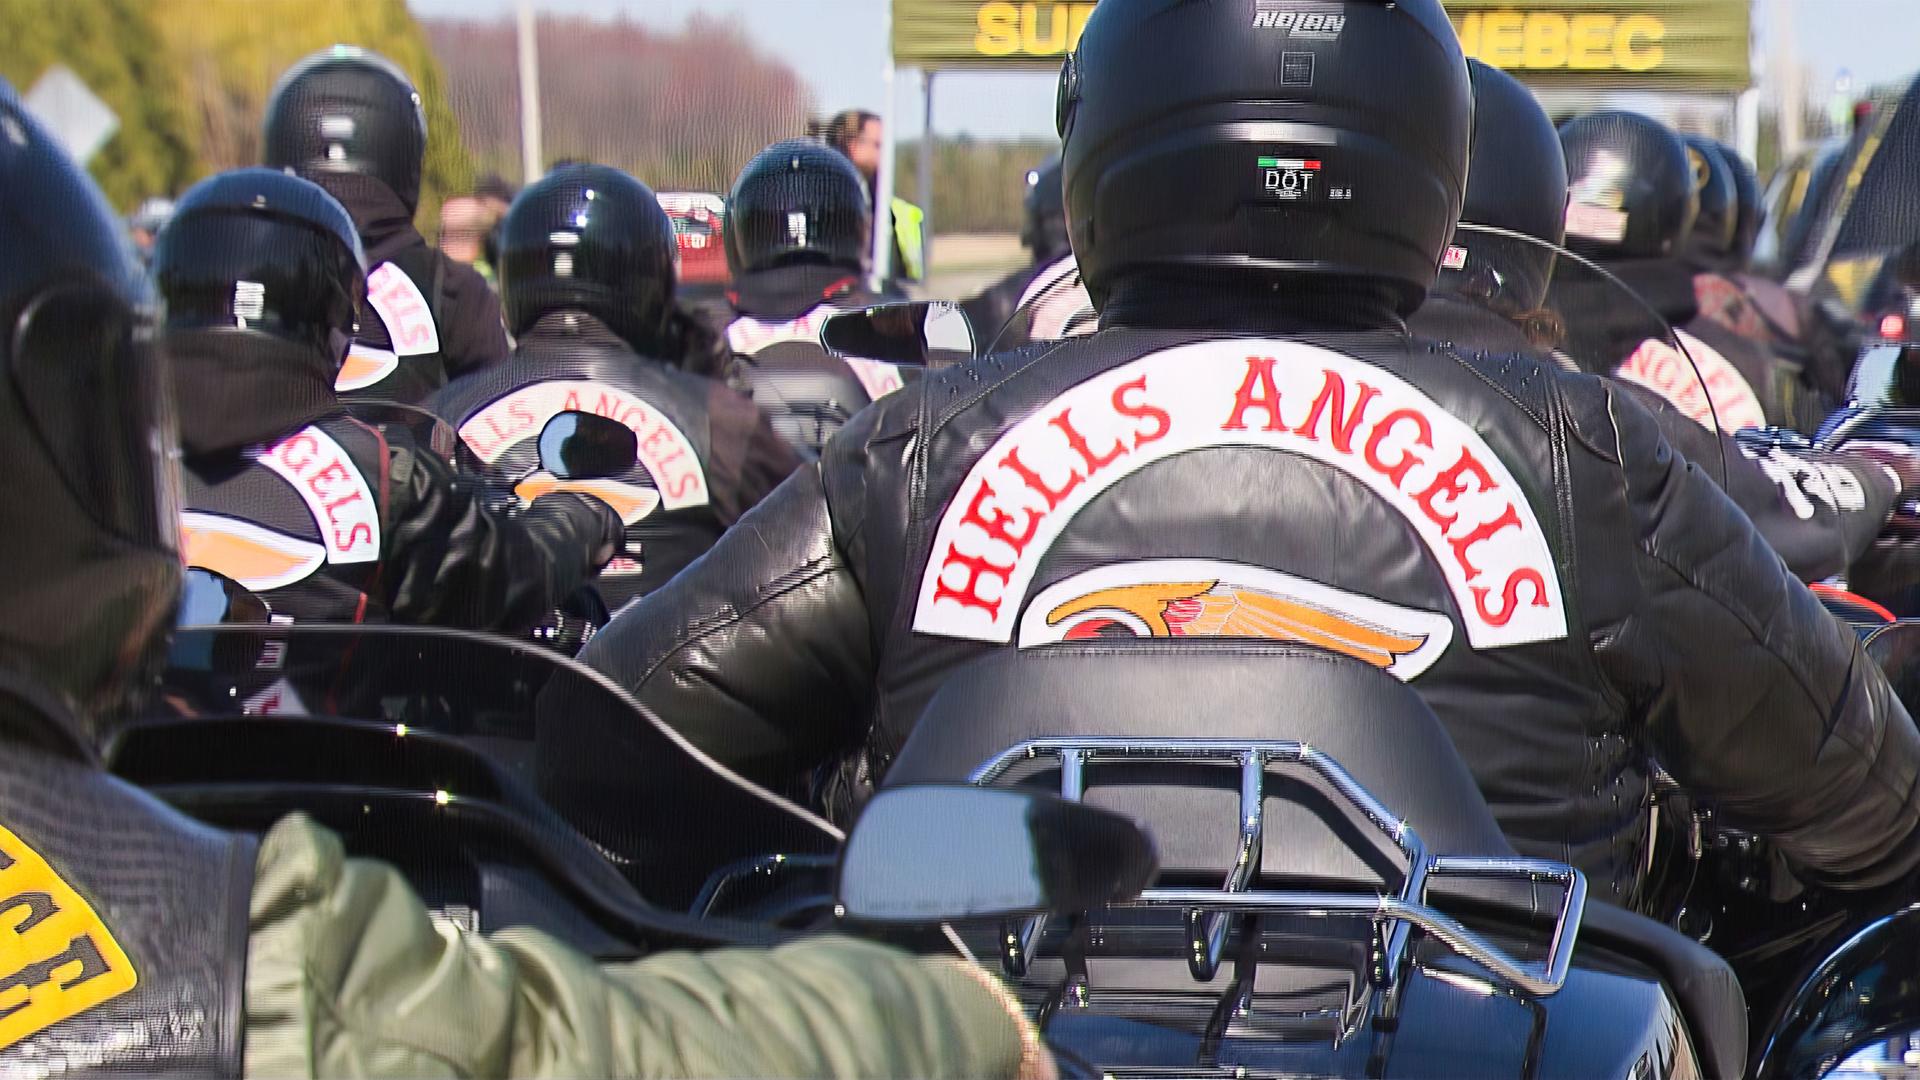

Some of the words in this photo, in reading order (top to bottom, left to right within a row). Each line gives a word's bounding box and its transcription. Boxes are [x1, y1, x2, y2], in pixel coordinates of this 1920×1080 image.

[1252, 10, 1346, 40] NOLAN
[1265, 170, 1314, 191] DOT
[464, 400, 534, 461] LLS
[279, 433, 372, 551] GELS
[933, 374, 1172, 623] HELLS
[1222, 355, 1550, 628] ANGELS
